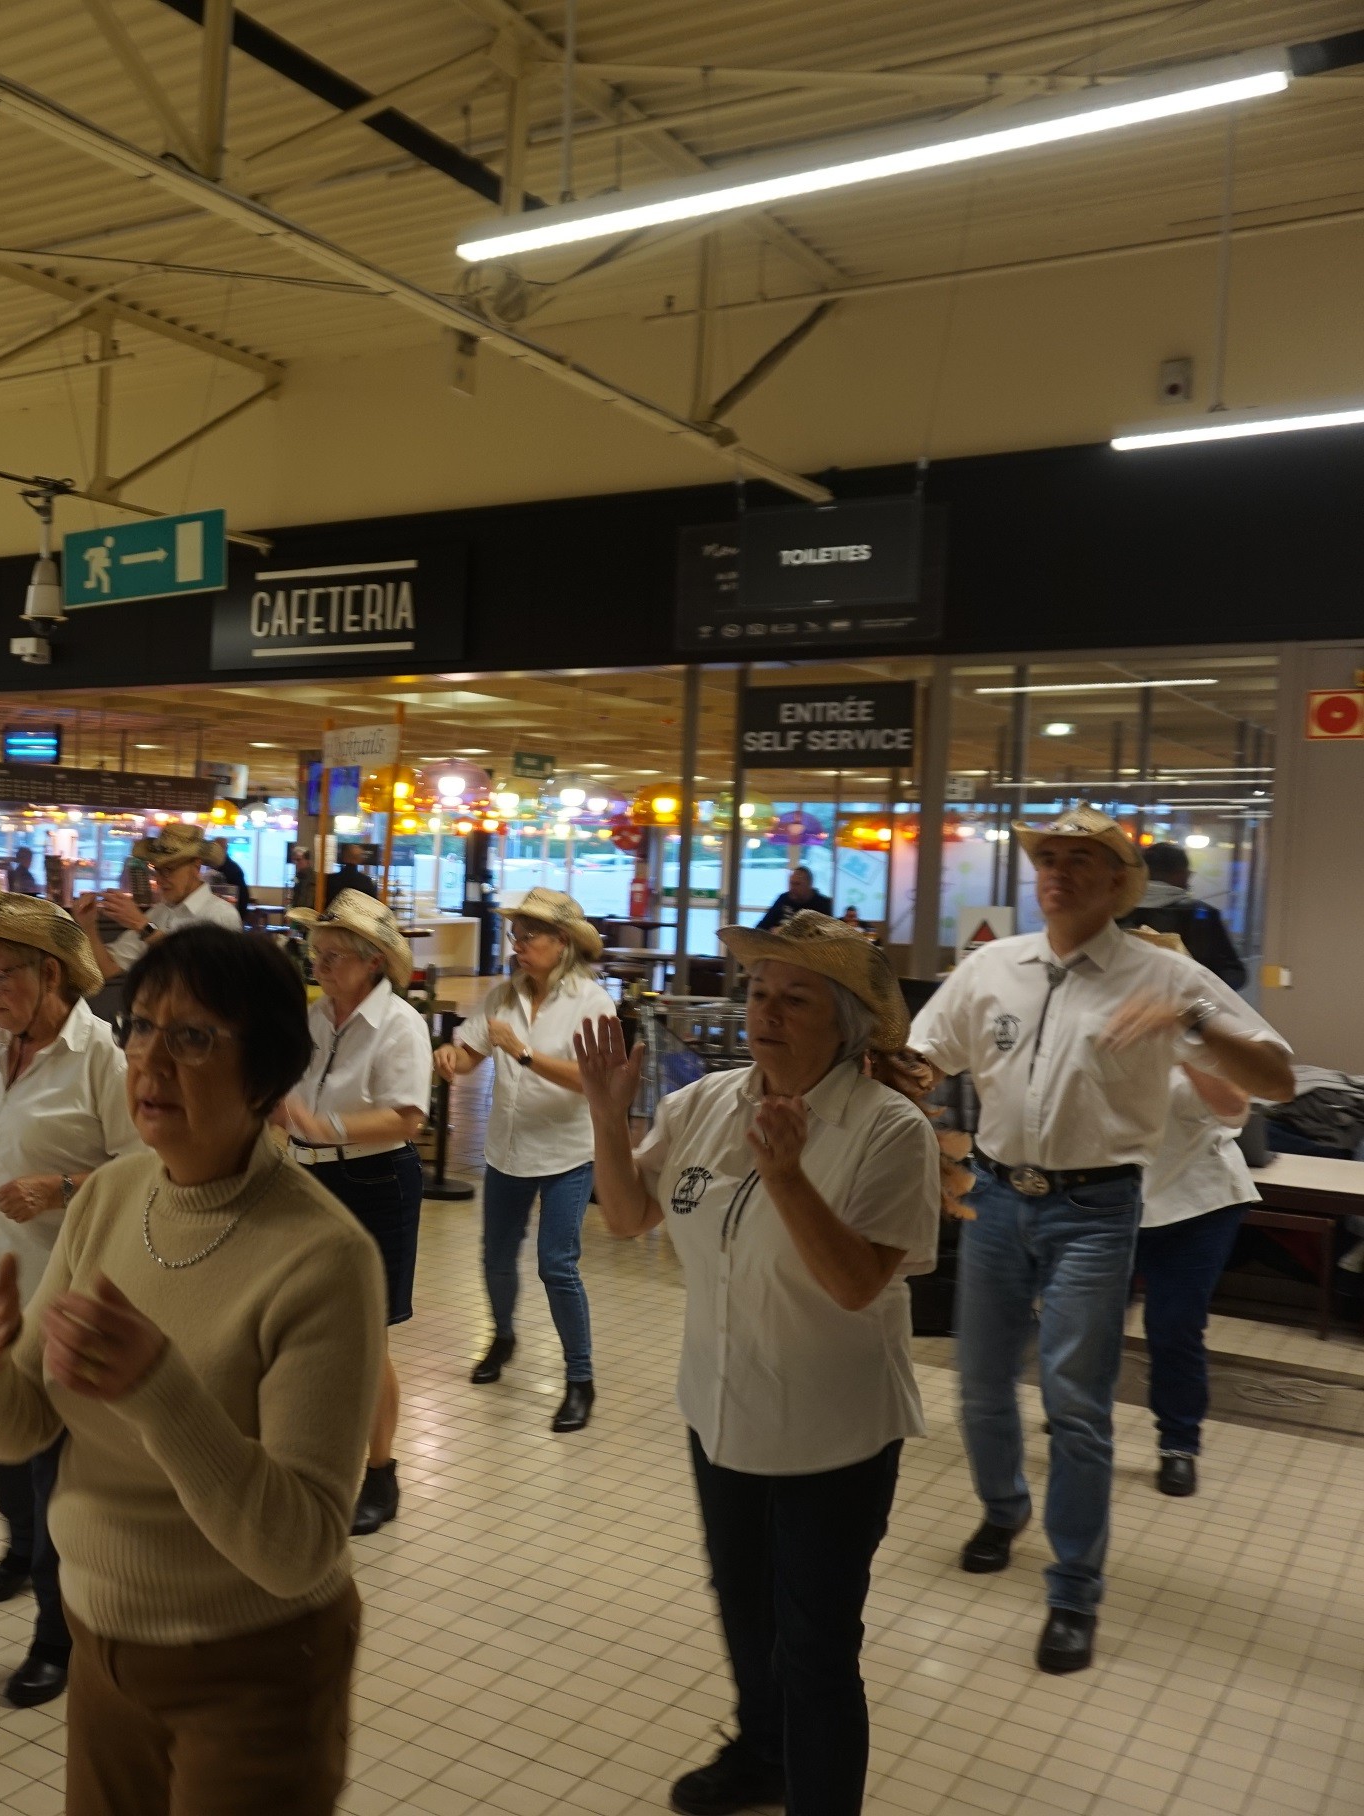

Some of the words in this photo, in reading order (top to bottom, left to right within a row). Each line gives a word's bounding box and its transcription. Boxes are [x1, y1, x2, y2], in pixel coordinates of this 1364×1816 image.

[778, 544, 872, 567] TOILETTES
[250, 581, 416, 638] CAFETERIA
[779, 696, 876, 725] ENTRÉE
[743, 731, 803, 753] SELF
[807, 728, 914, 752] SERVICE
